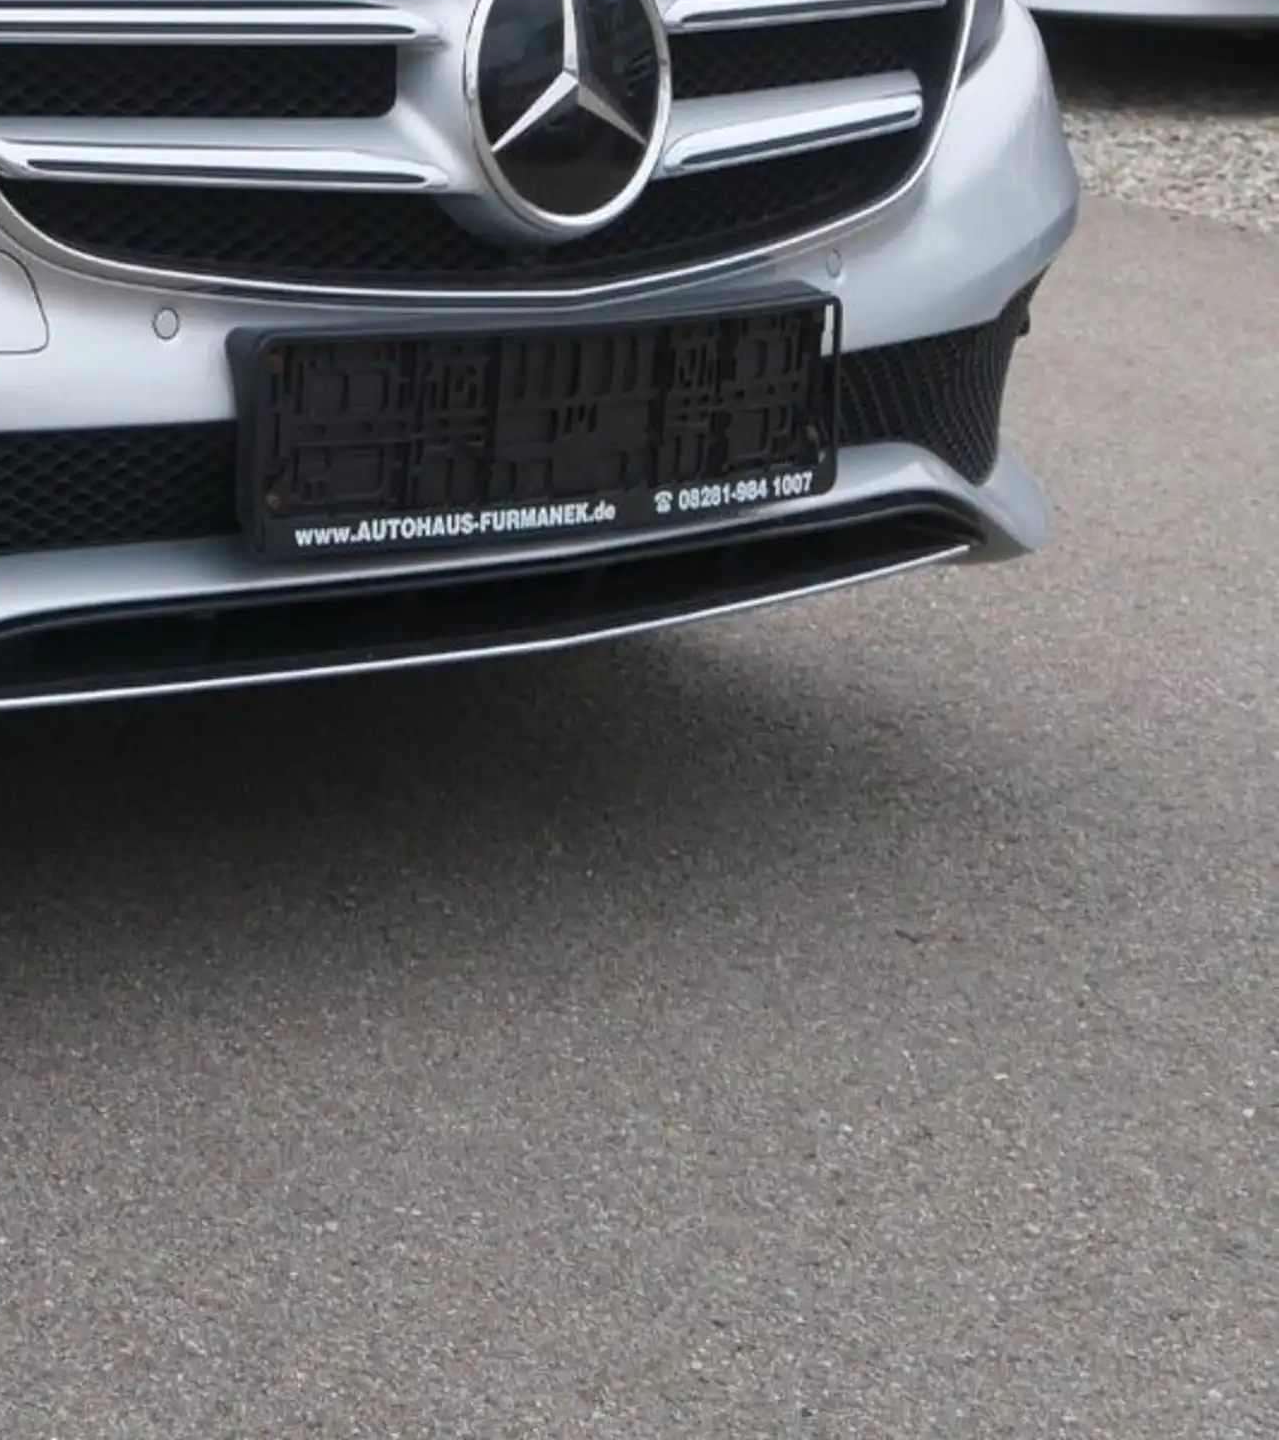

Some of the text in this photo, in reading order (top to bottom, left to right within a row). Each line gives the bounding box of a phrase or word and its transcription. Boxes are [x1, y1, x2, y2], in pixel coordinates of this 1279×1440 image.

[295, 471, 813, 546] www.AUTOHAUS-FURMANEK.de 08281-984 1007
